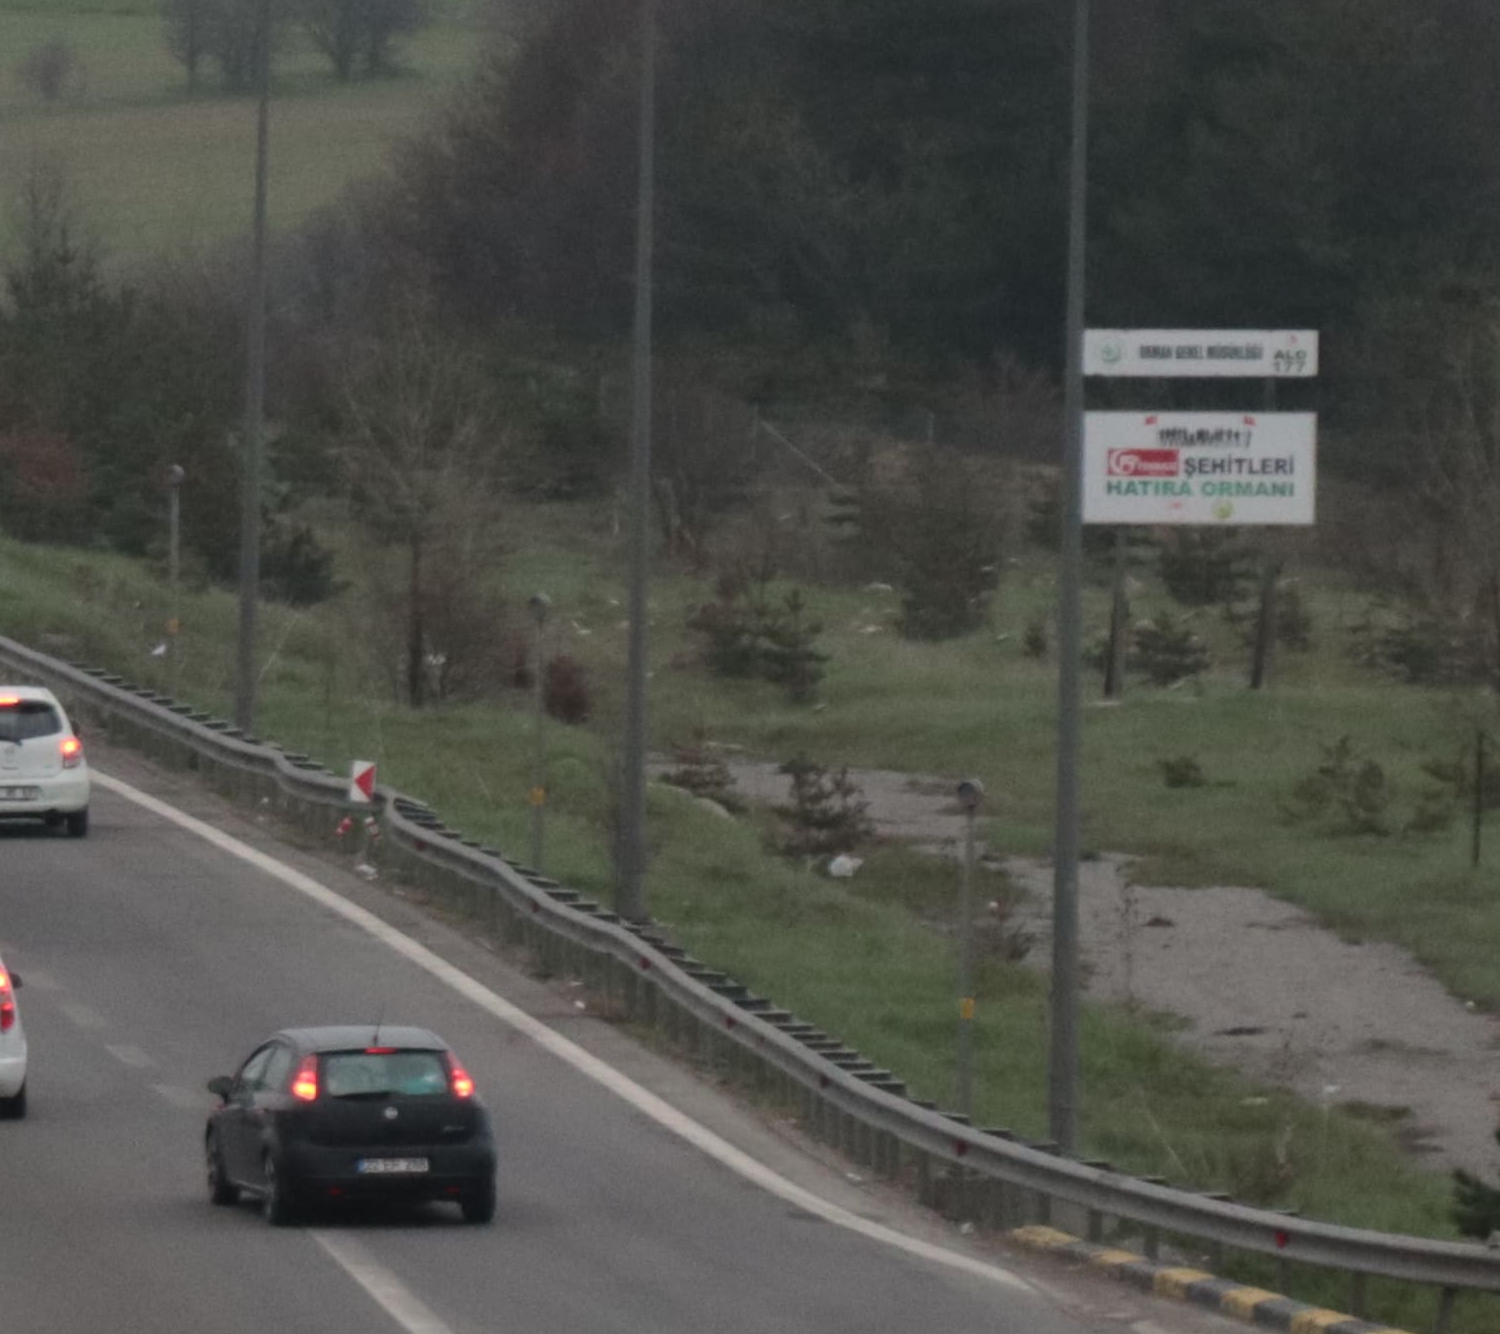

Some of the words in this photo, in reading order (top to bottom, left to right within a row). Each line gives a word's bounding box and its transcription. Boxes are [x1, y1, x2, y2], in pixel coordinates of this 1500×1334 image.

[1273, 349, 1308, 360] ALO
[1184, 454, 1295, 478] ŞEHİTLERİ
[1107, 480, 1192, 496] HATIRA
[1202, 481, 1295, 497] ORMANI
